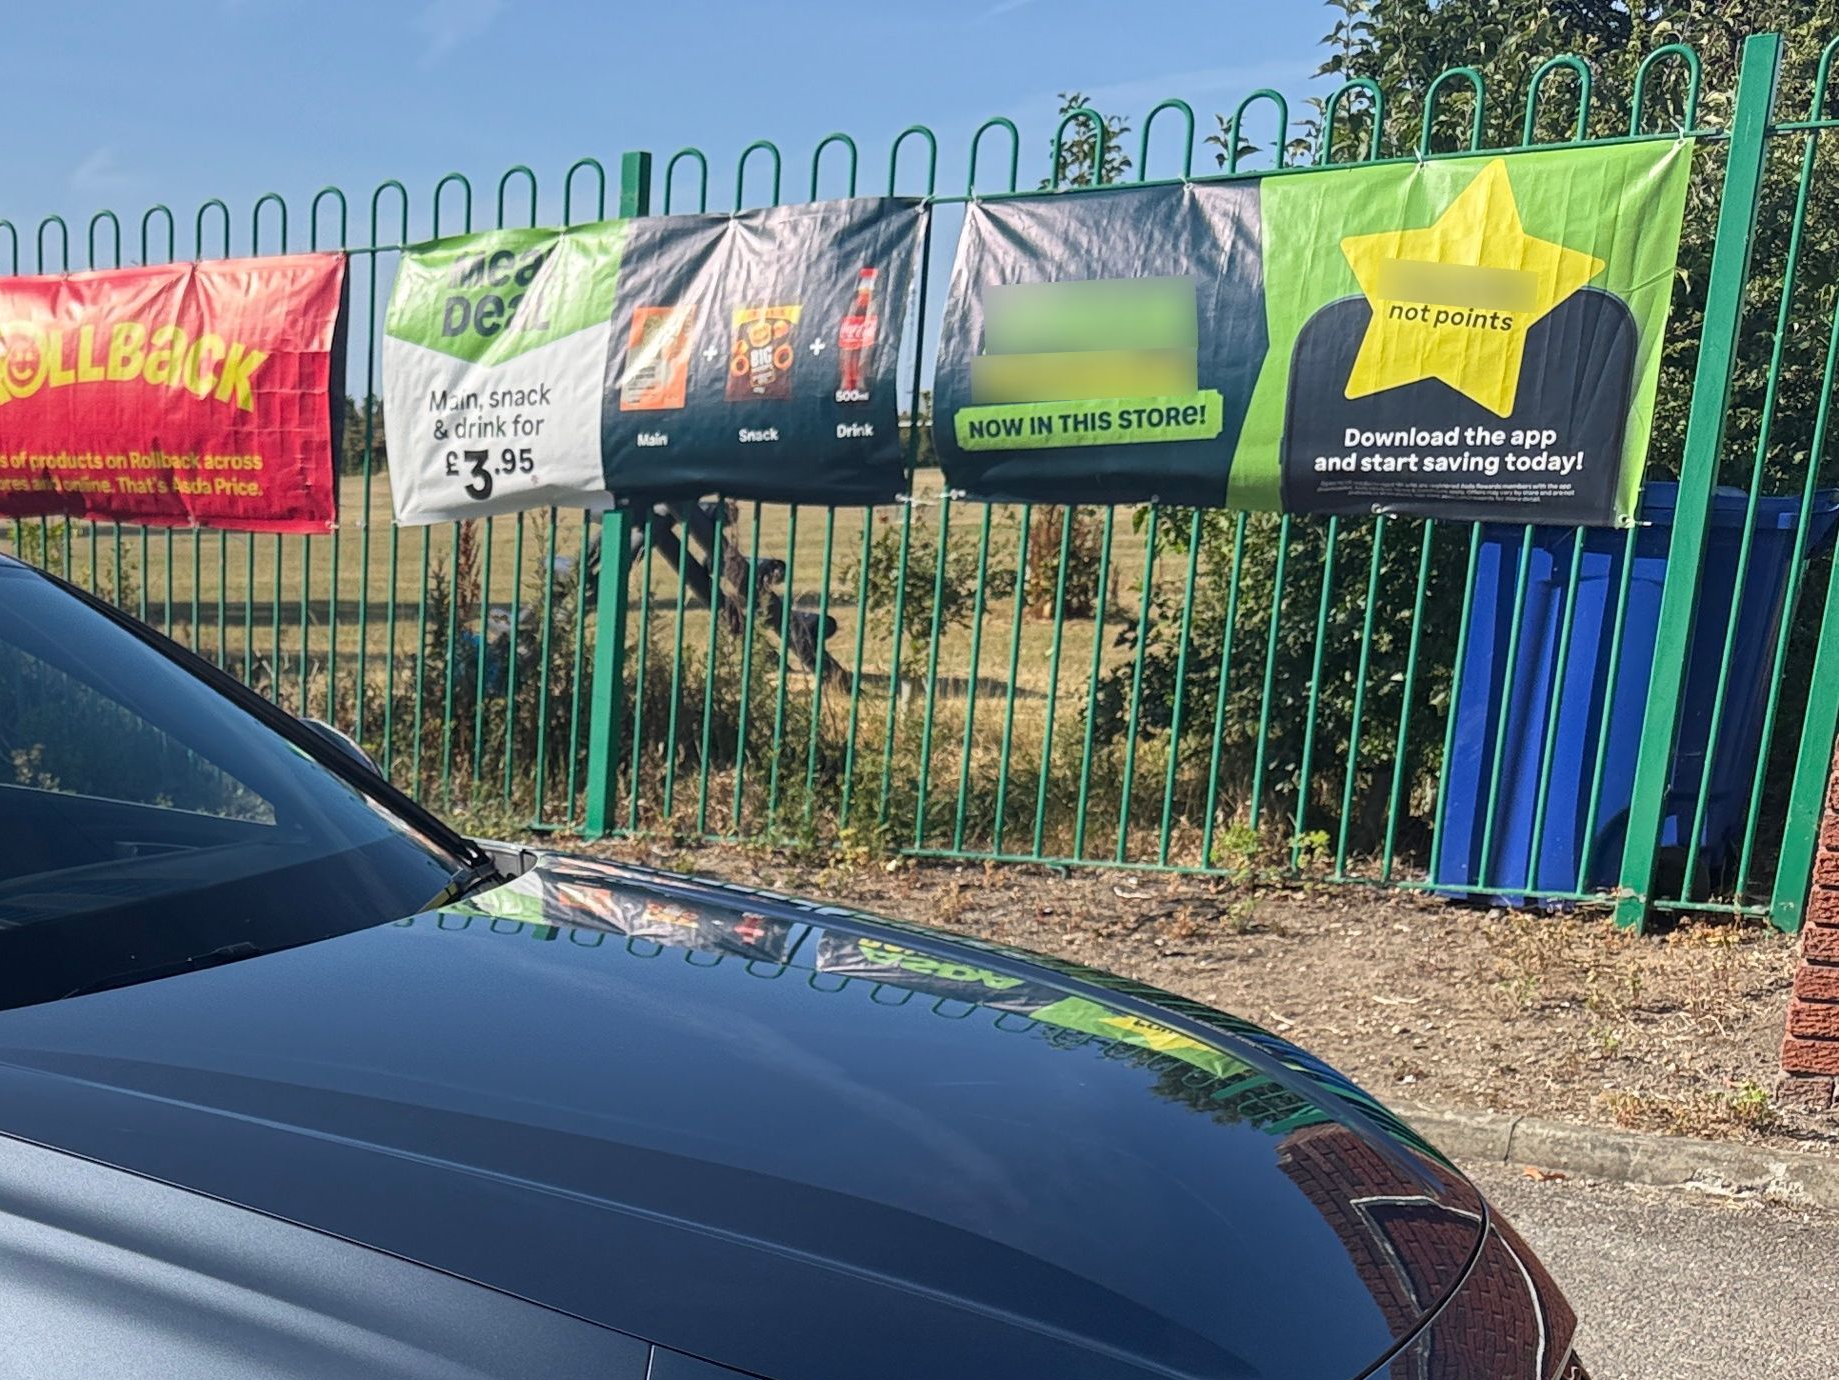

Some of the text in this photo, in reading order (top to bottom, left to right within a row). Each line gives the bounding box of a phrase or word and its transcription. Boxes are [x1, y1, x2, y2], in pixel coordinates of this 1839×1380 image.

[1389, 304, 1513, 331] not points
[429, 382, 551, 412] Main, snack
[433, 413, 545, 440] & drink for
[738, 428, 779, 443] Snack
[836, 423, 874, 439] Drink
[968, 418, 1023, 440] NOW
[1030, 415, 1053, 435] IN
[1059, 411, 1112, 434] THIS
[1344, 426, 1557, 449] Download the app
[637, 432, 668, 448] Main
[10, 451, 27, 469] of
[29, 451, 104, 473] products
[106, 455, 128, 469] on
[129, 451, 203, 470] Rollback
[204, 455, 263, 470] across
[446, 448, 534, 500] £3.95
[1314, 451, 1584, 476] and start saving today!
[32, 475, 61, 493] and
[116, 476, 168, 494] That's
[214, 476, 263, 496] Price.
